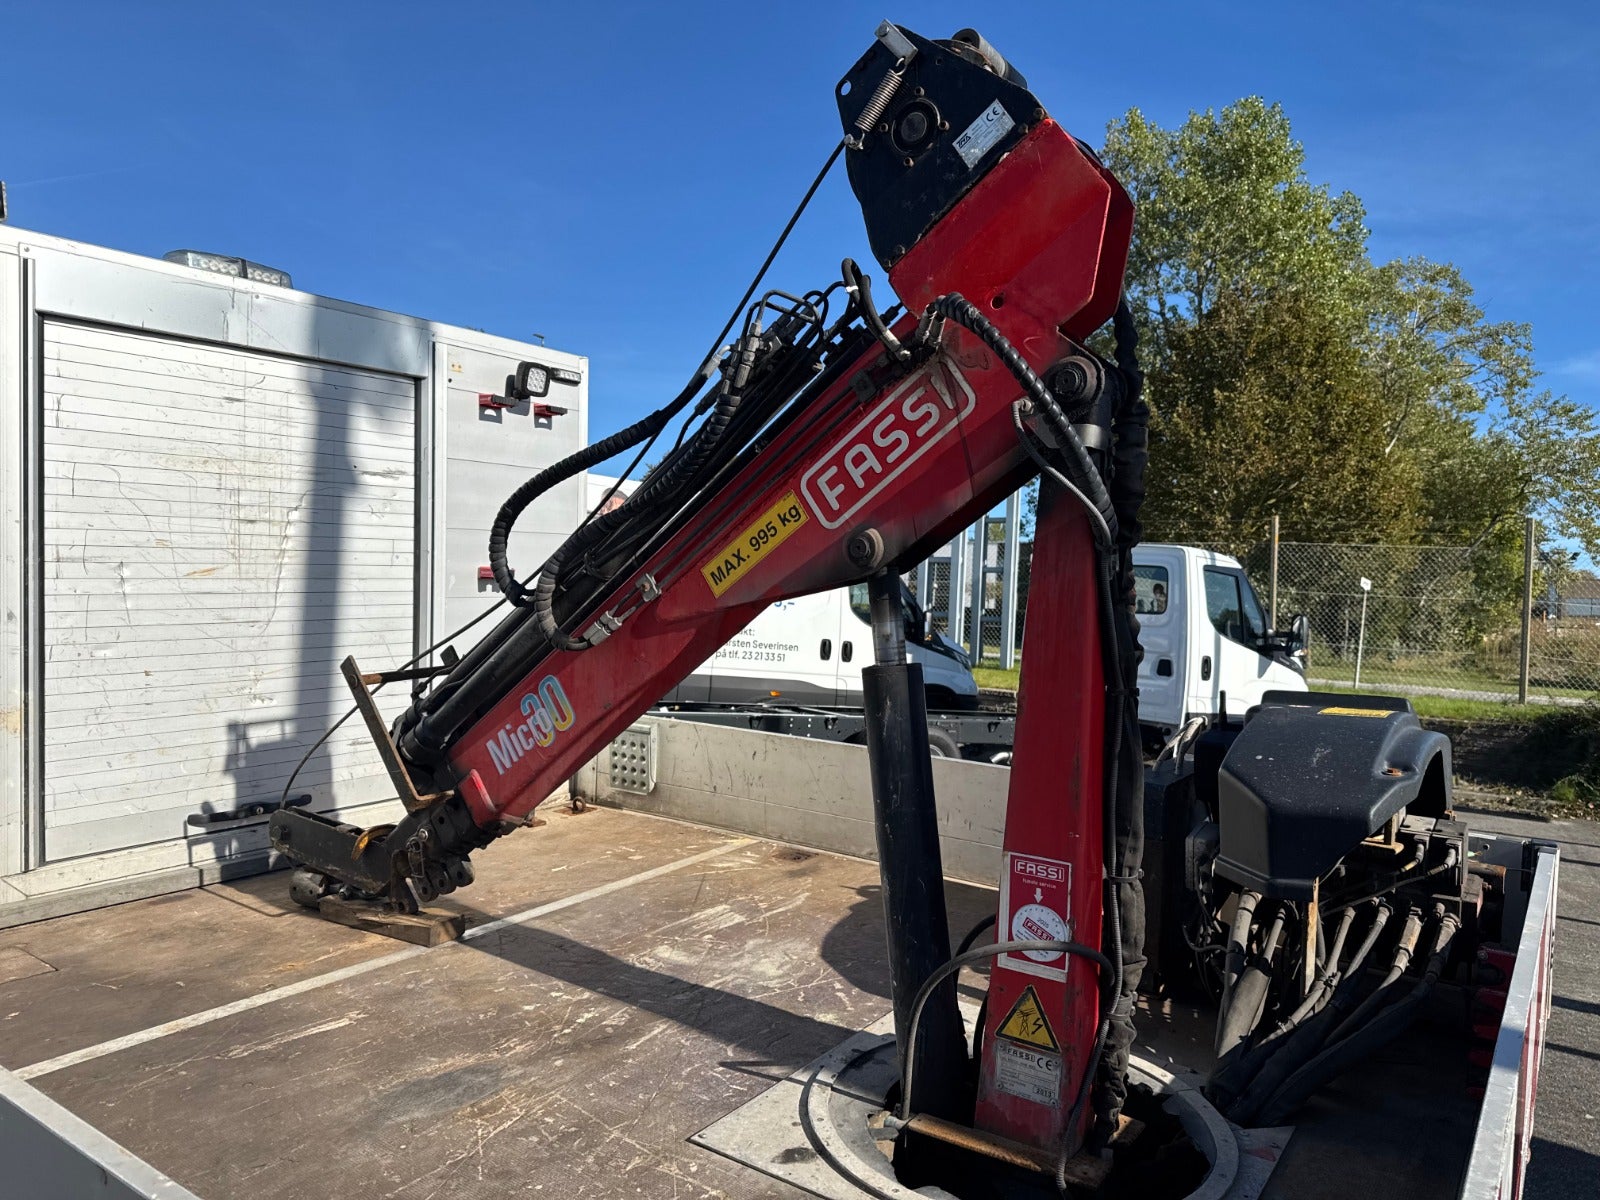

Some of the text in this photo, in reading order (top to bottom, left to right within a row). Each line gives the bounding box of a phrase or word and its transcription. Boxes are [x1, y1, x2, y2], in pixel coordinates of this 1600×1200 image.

[986, 106, 1000, 122] CE
[816, 375, 955, 511] FASSI
[709, 504, 801, 586] MAX. 995 kg
[752, 640, 799, 652] Severinsen
[729, 650, 740, 659] tlf.
[742, 651, 753, 660] 23
[754, 652, 763, 661] 21
[765, 652, 775, 662] 33
[777, 653, 786, 662] 51
[486, 707, 553, 775] Micro
[1016, 861, 1062, 880] FASSI
[1007, 1047, 1034, 1062] FASSI
[1036, 1057, 1053, 1071] CE
